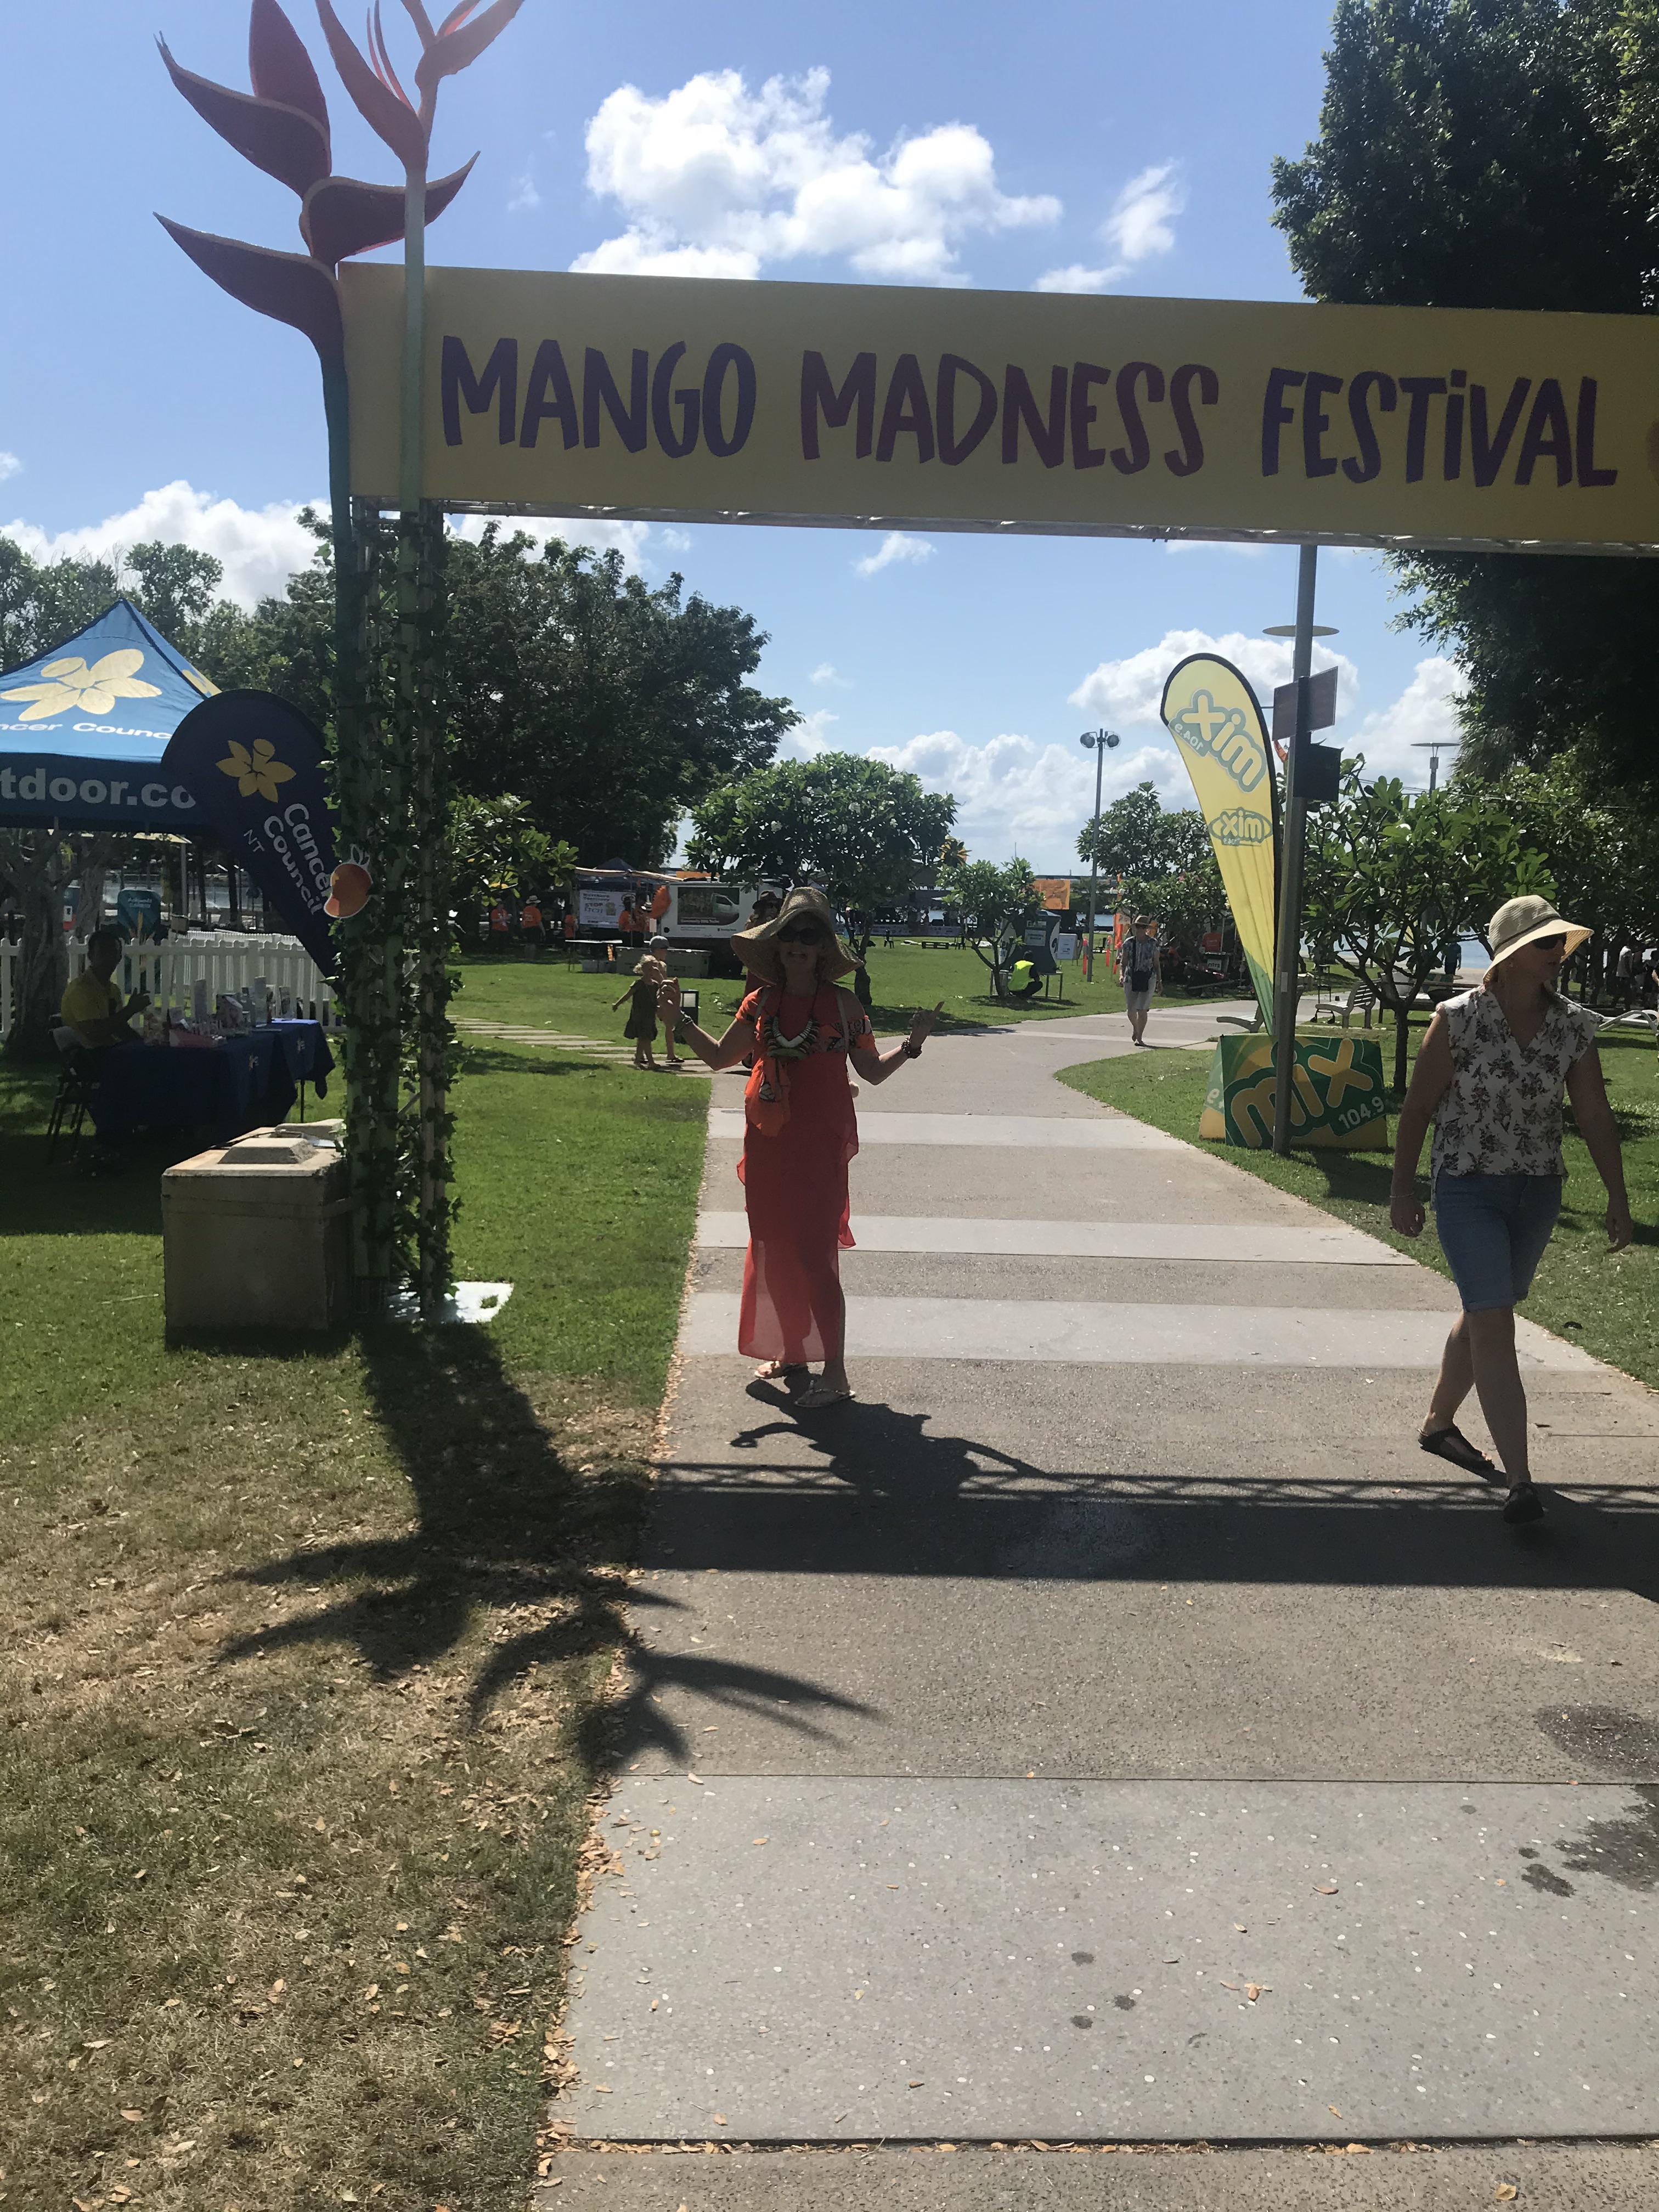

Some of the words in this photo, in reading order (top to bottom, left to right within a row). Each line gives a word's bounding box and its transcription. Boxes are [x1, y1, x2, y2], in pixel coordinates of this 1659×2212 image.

[441, 335, 757, 459] MANGO
[800, 349, 1219, 477] MADNESS
[243, 829, 266, 853] NT
[263, 815, 323, 916] Council
[1338, 1096, 1385, 1129] 104.9
